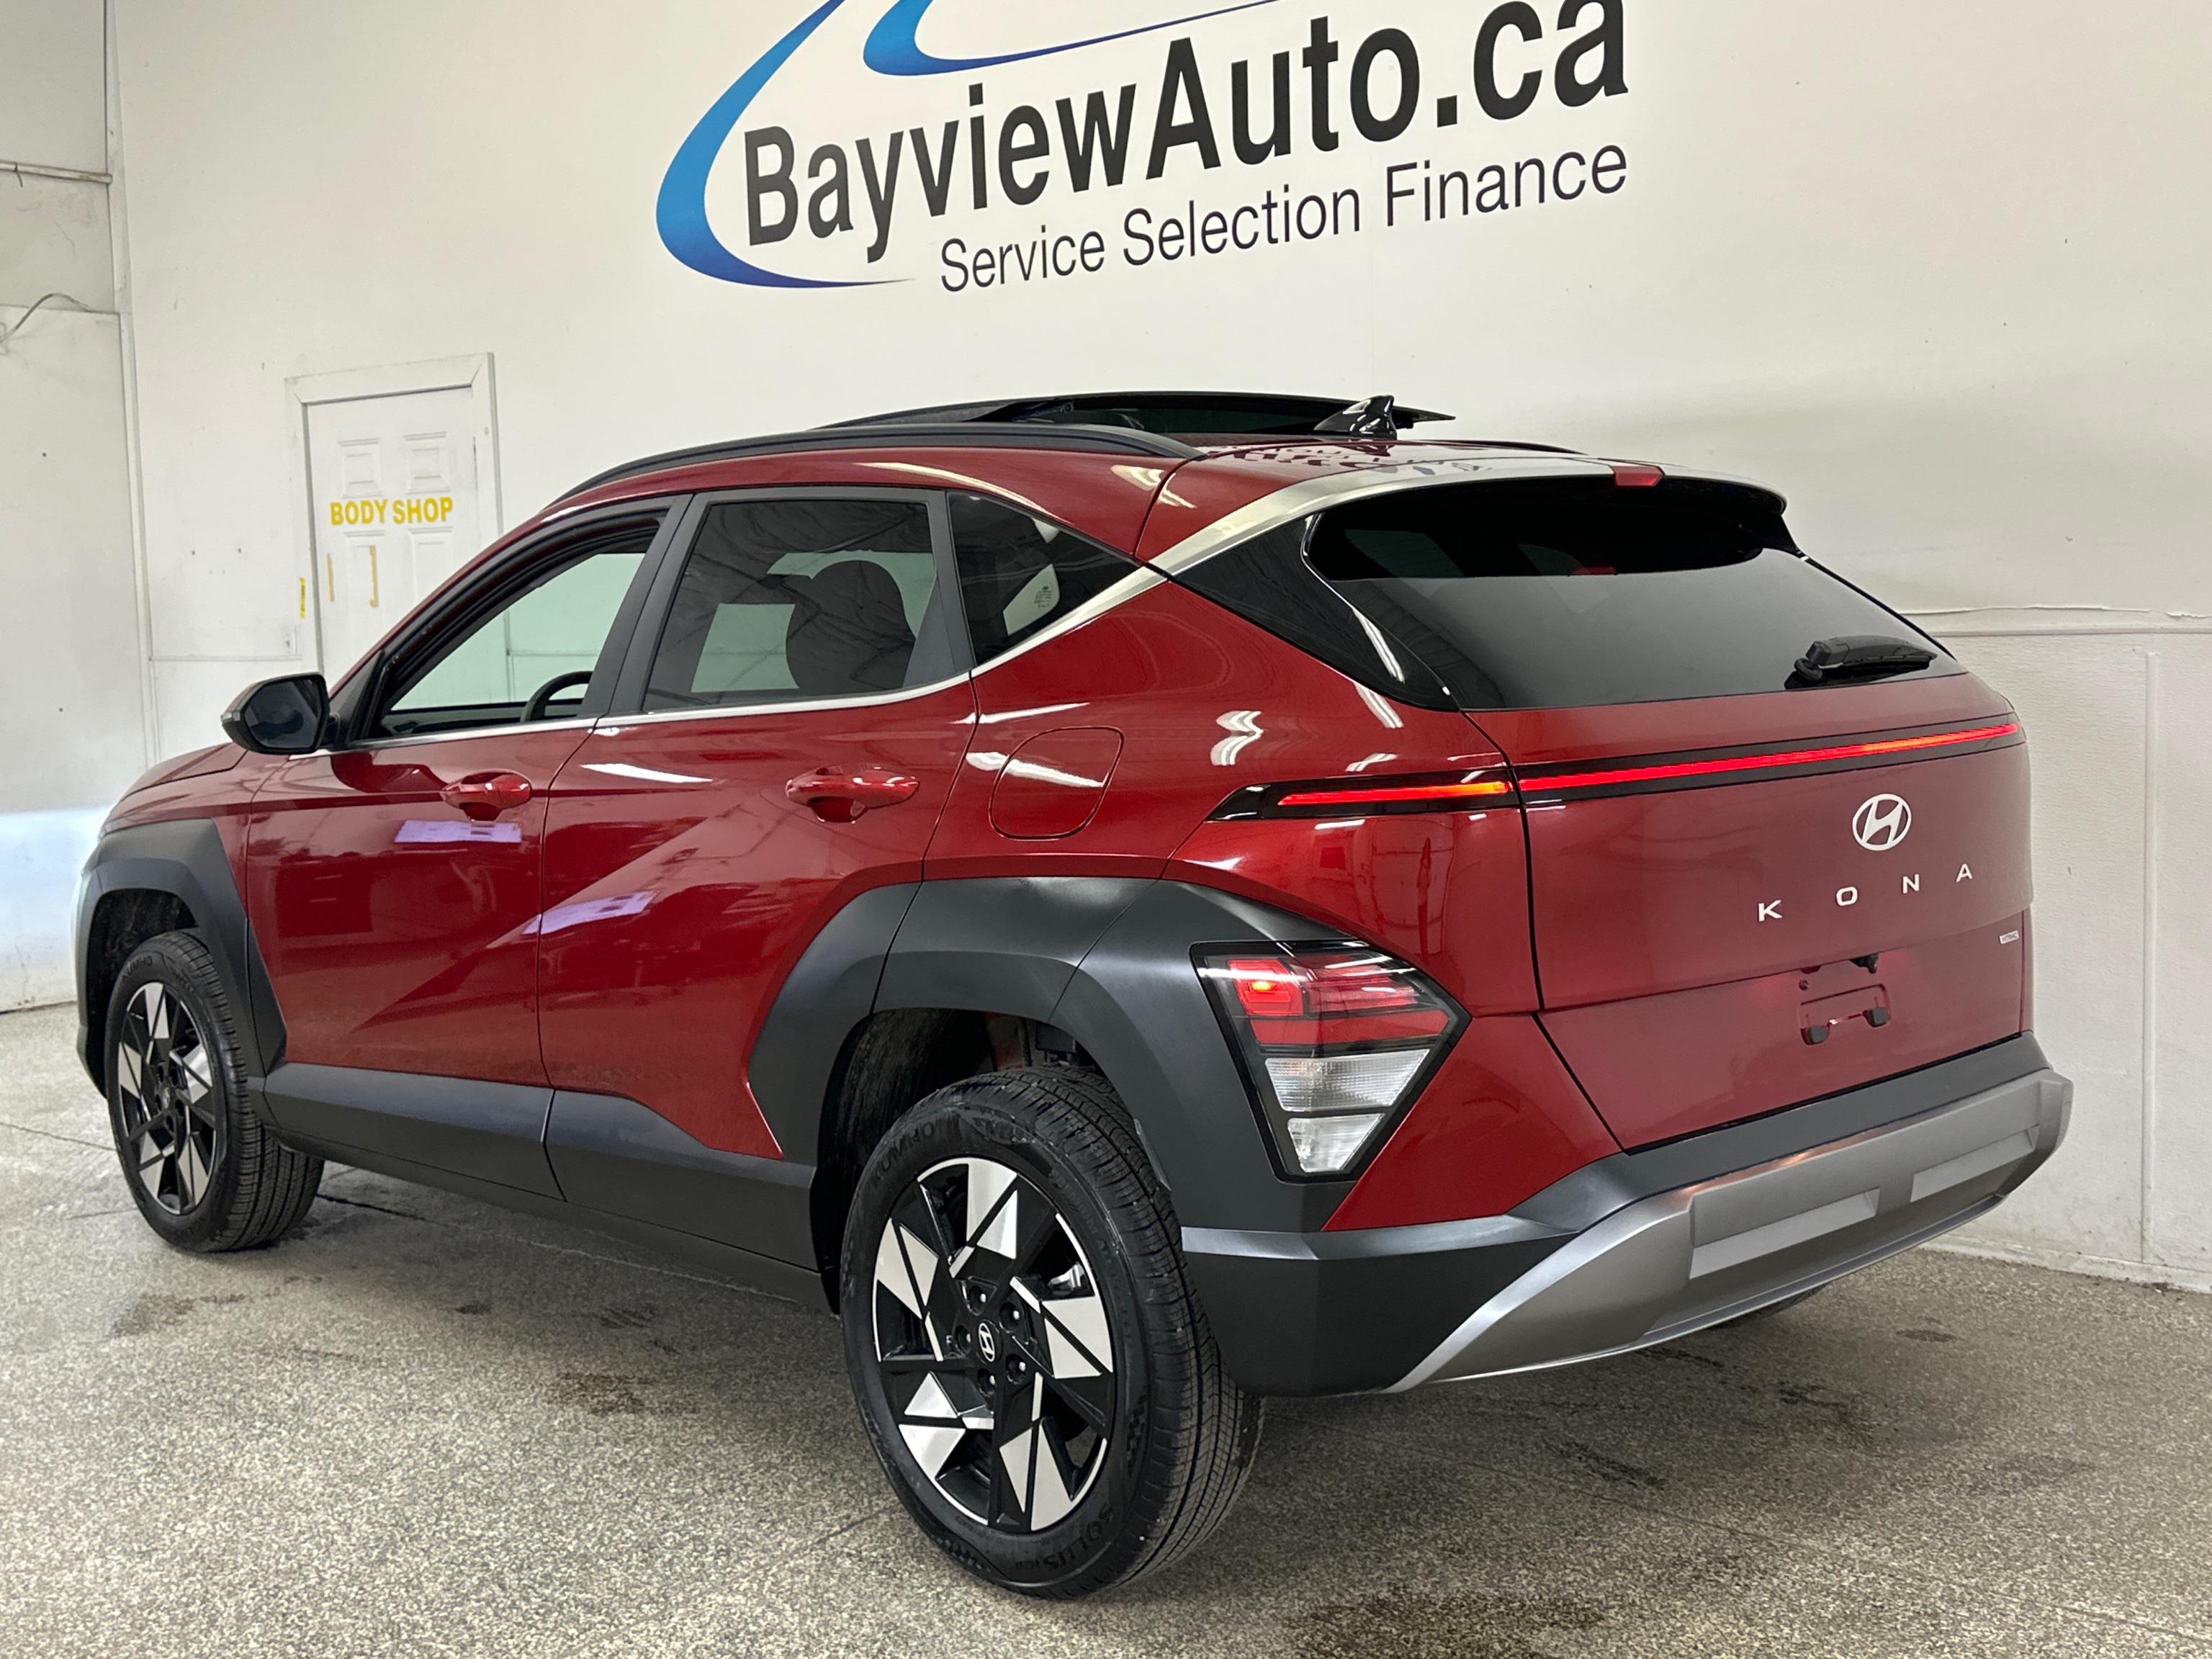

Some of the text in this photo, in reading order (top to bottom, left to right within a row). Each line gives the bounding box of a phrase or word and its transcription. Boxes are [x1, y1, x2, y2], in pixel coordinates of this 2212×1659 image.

[745, 0, 1629, 264] BayviewAuto.ca
[940, 143, 1628, 292] Service Selection Finance
[329, 496, 454, 526] BODY SHOP
[1758, 863, 1973, 922] KONA
